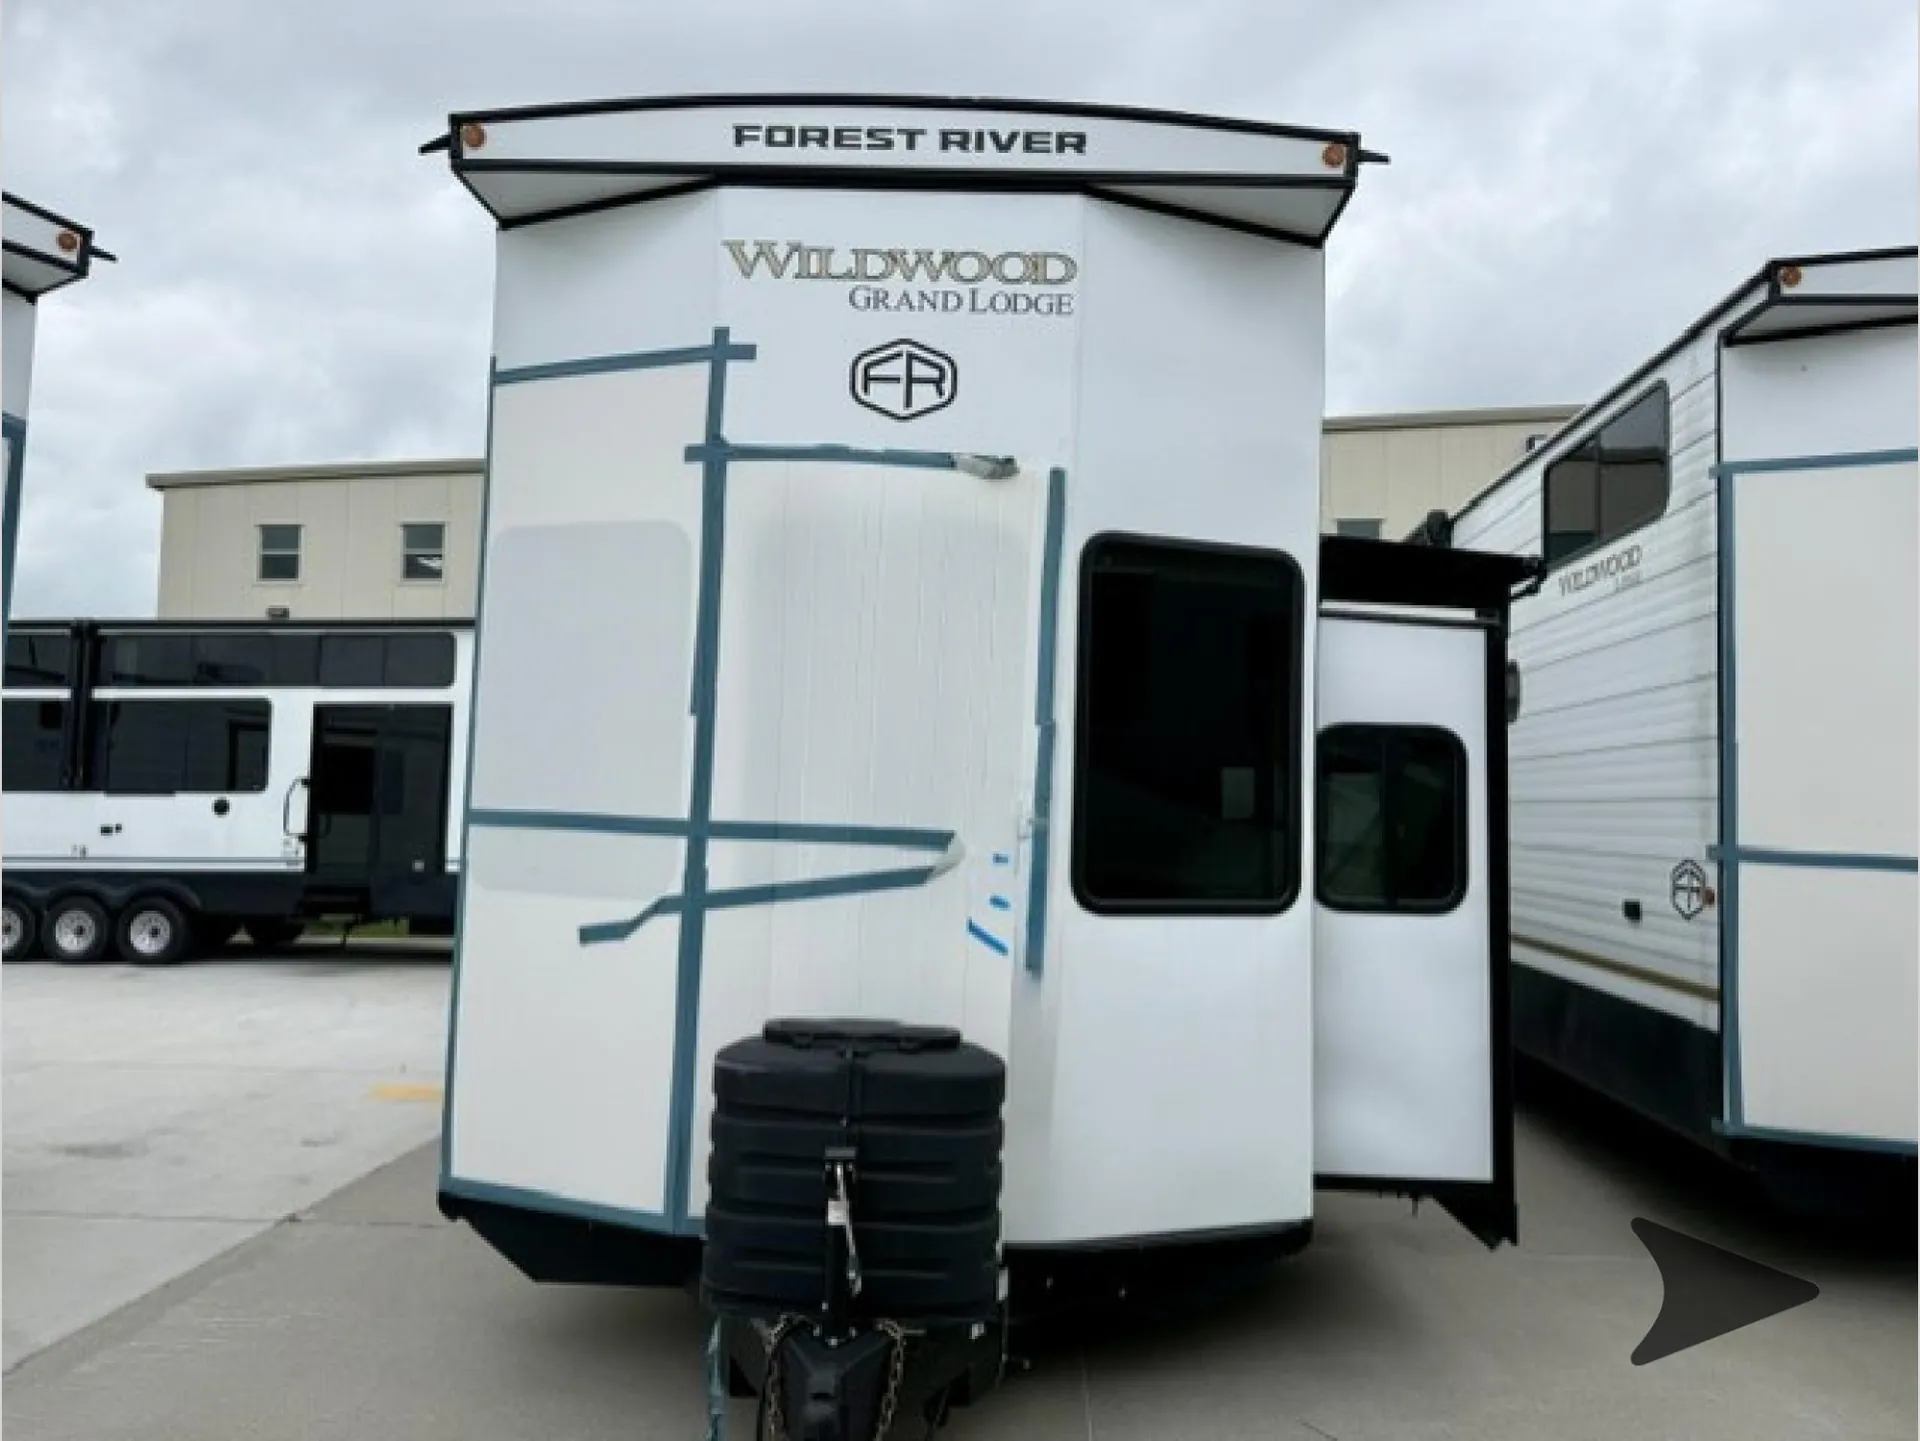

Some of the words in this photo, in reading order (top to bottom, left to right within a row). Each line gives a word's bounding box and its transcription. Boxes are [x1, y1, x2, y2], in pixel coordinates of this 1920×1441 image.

[733, 124, 926, 150] FOREST
[938, 128, 1087, 153] RIVER
[721, 239, 1078, 285] WILDWOOD
[848, 285, 964, 313] GRAND
[968, 287, 1075, 315] LODGE
[858, 347, 950, 412] FR
[1559, 545, 1642, 596] WILDWOOD
